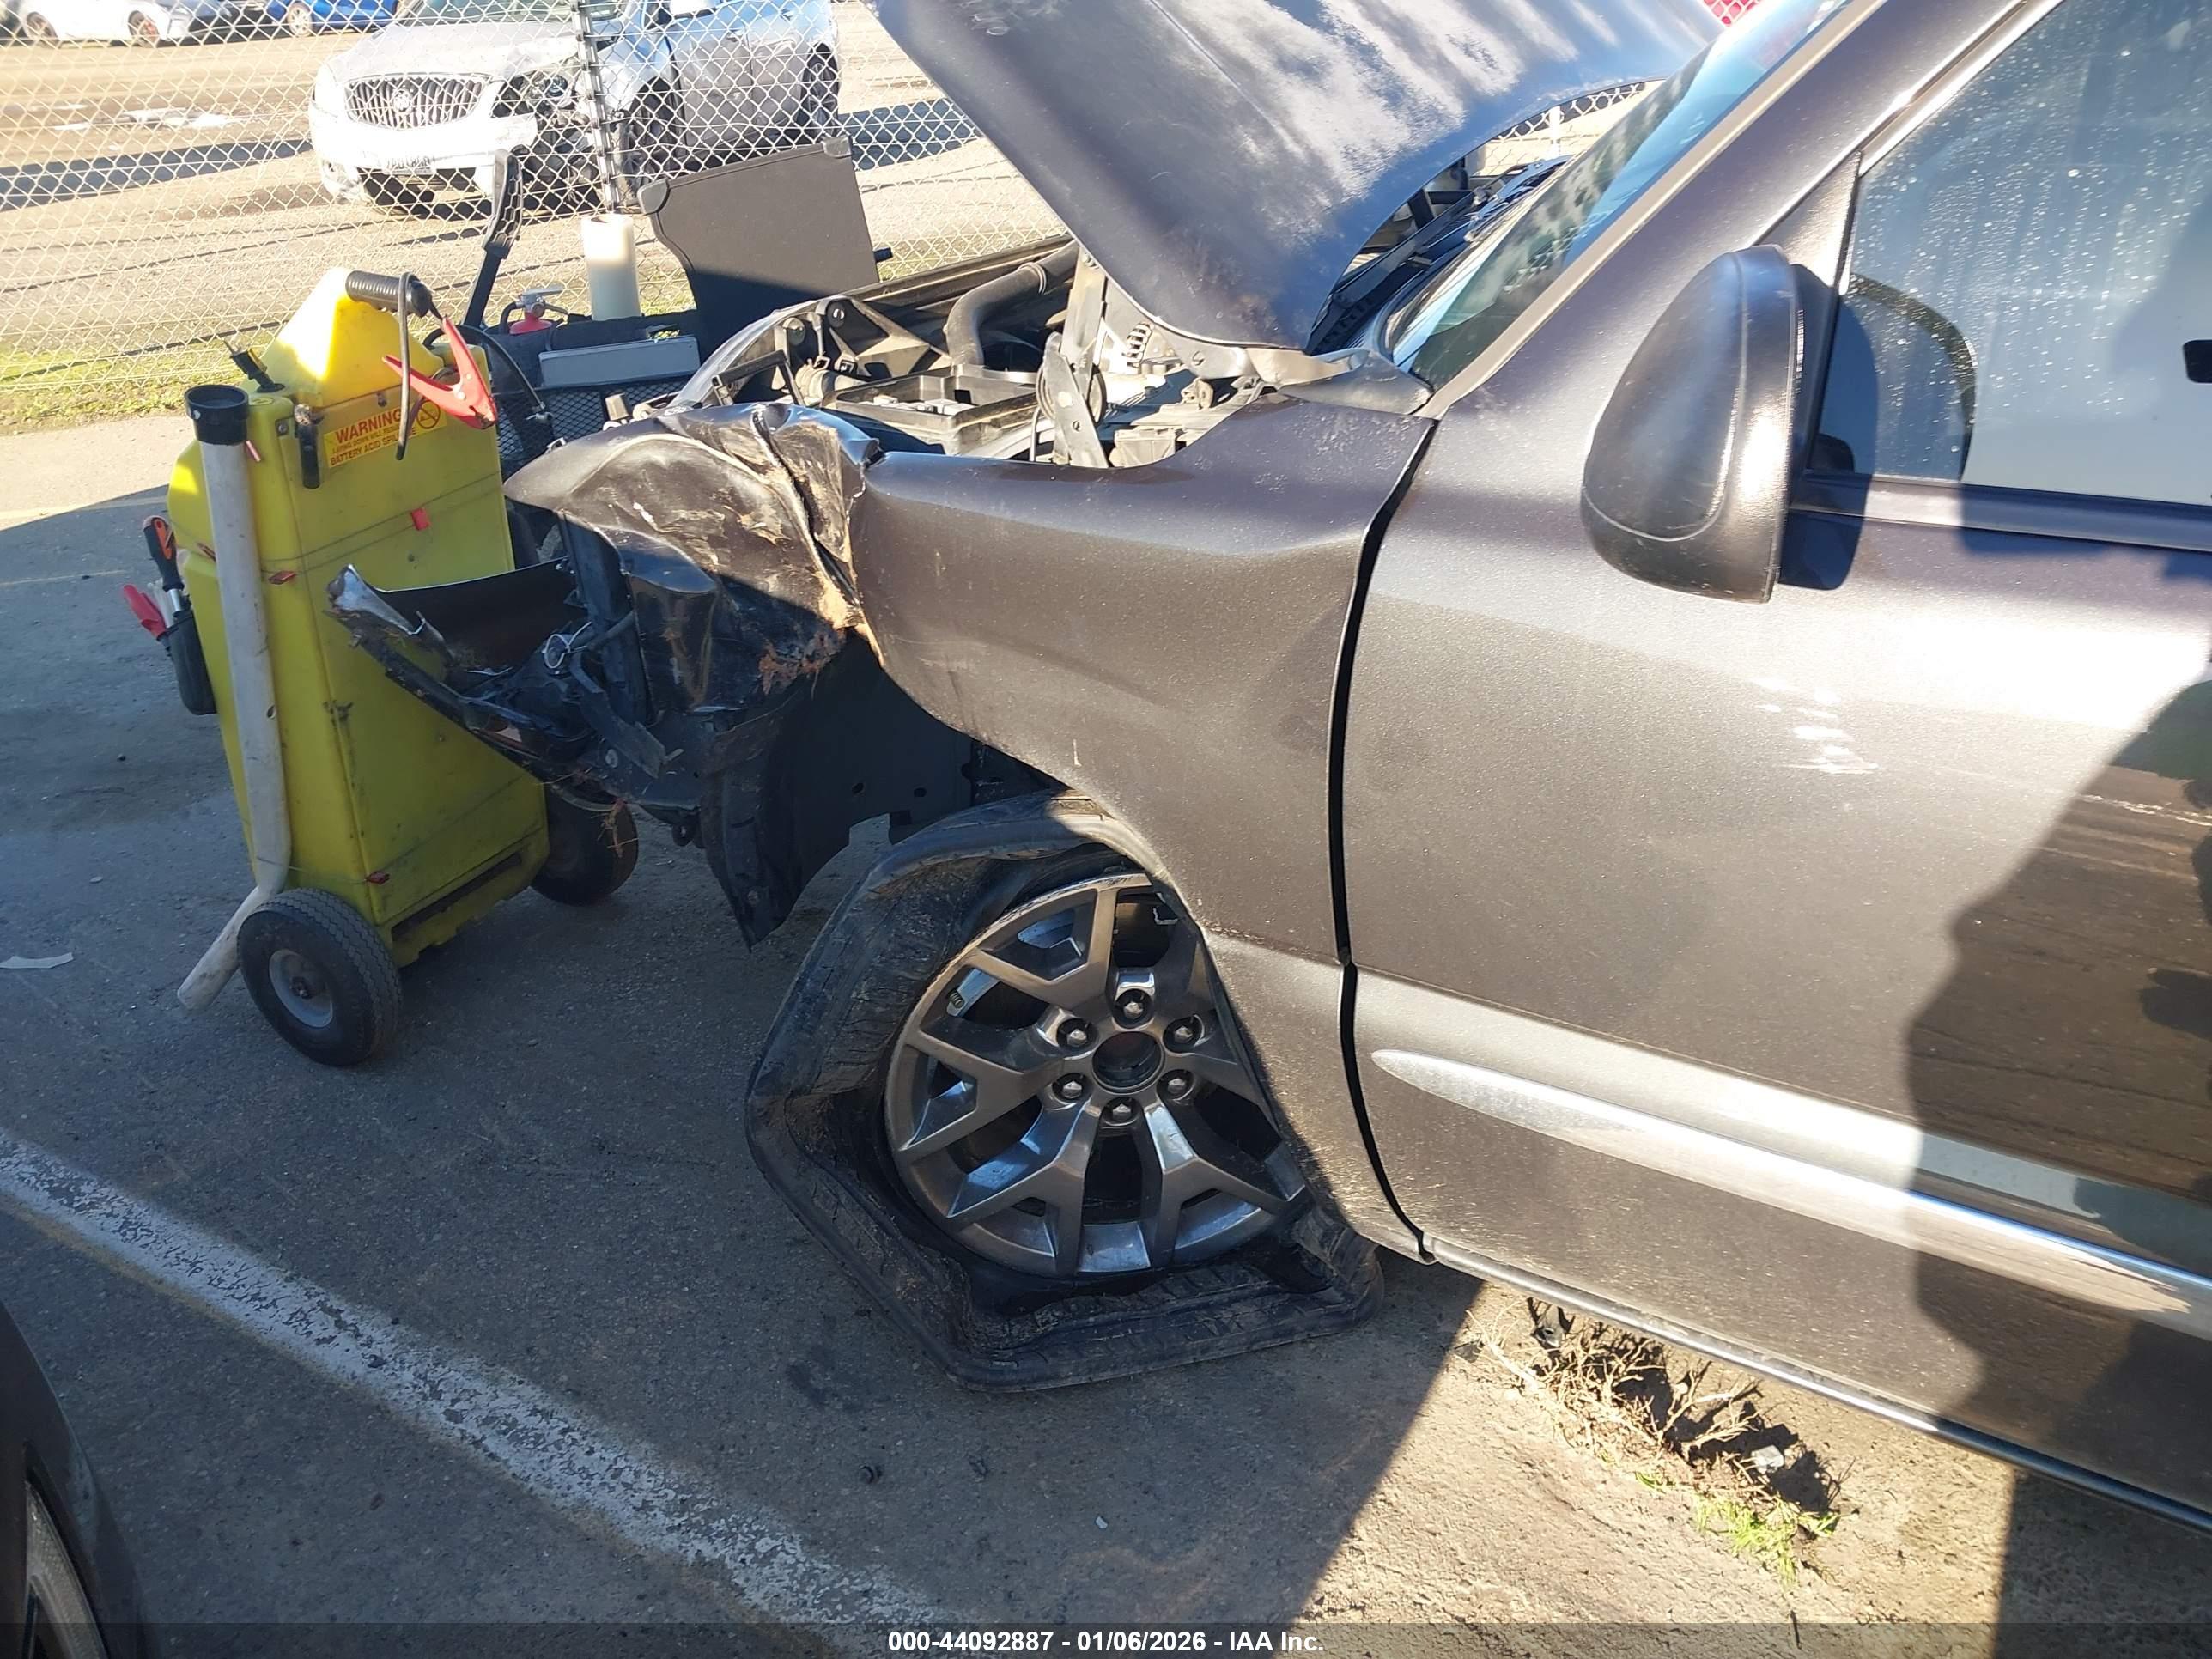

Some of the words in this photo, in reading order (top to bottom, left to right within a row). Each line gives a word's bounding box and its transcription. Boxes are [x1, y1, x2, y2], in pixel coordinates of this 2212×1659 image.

[336, 408, 402, 444] WARNING
[330, 447, 362, 466] BATTERY
[364, 440, 381, 453] ACID
